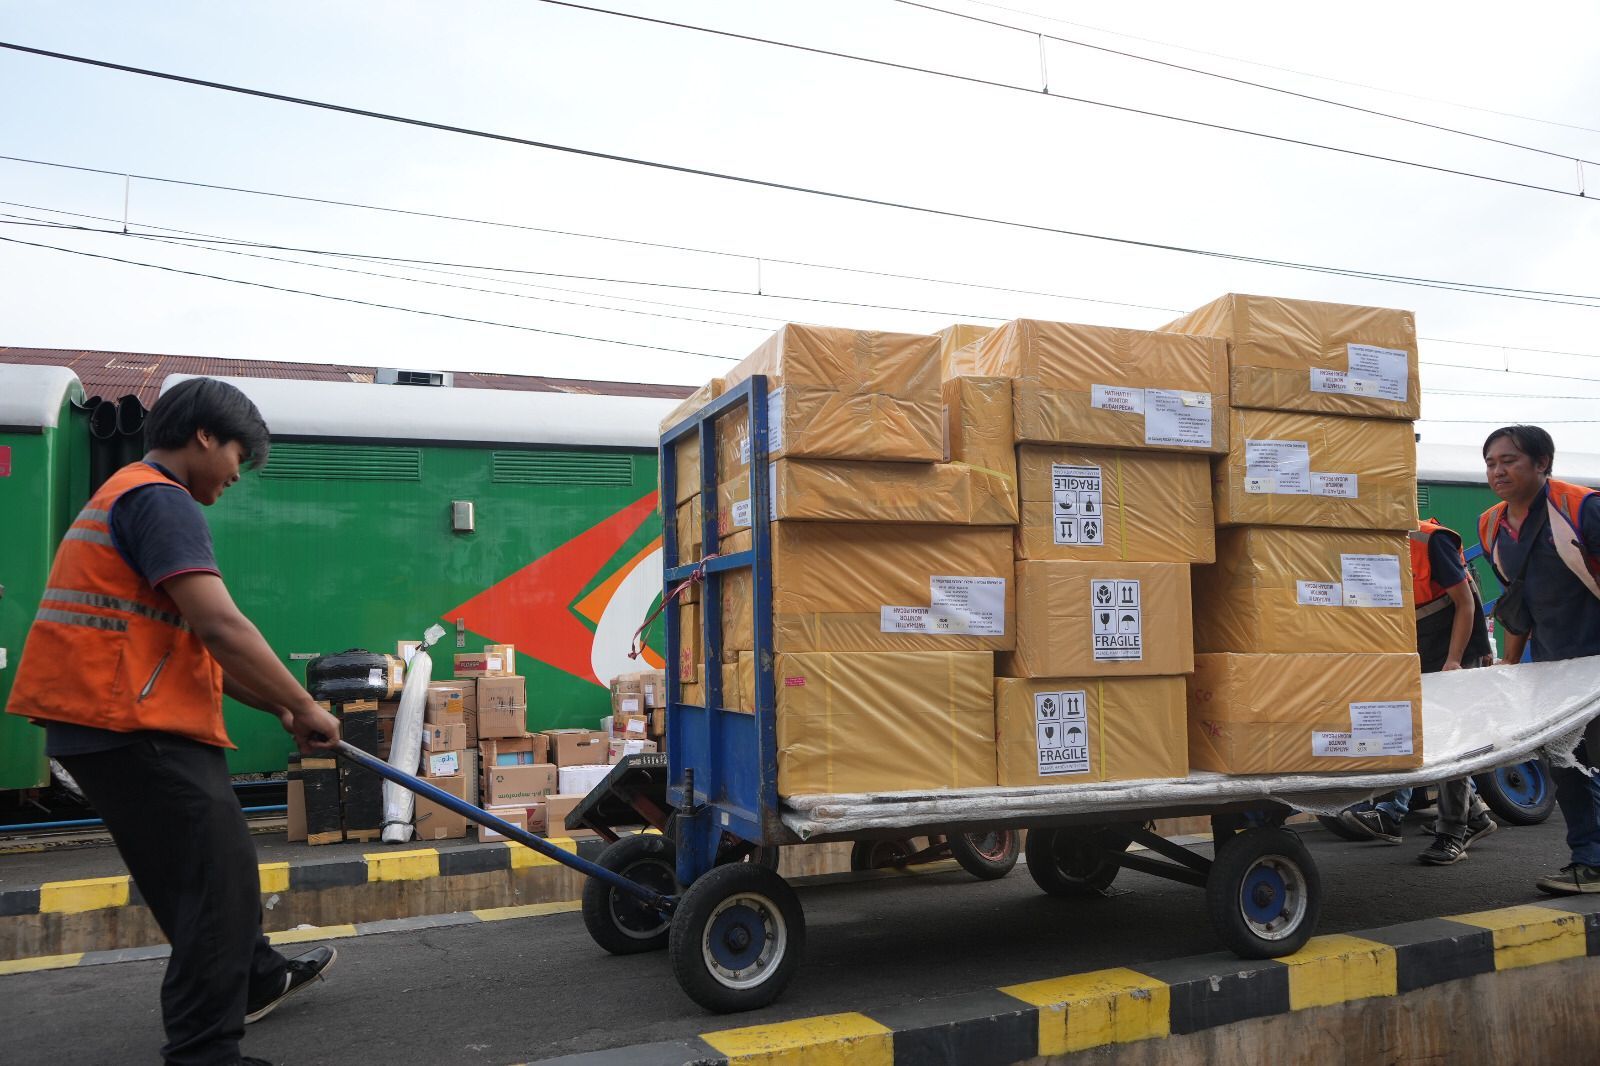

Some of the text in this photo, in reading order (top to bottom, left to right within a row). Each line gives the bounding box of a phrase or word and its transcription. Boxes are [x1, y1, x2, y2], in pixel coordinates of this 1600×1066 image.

[1054, 478, 1100, 490] FRAGILE
[1096, 636, 1140, 646] FRAGILE
[1040, 748, 1087, 761] FRAGILE
